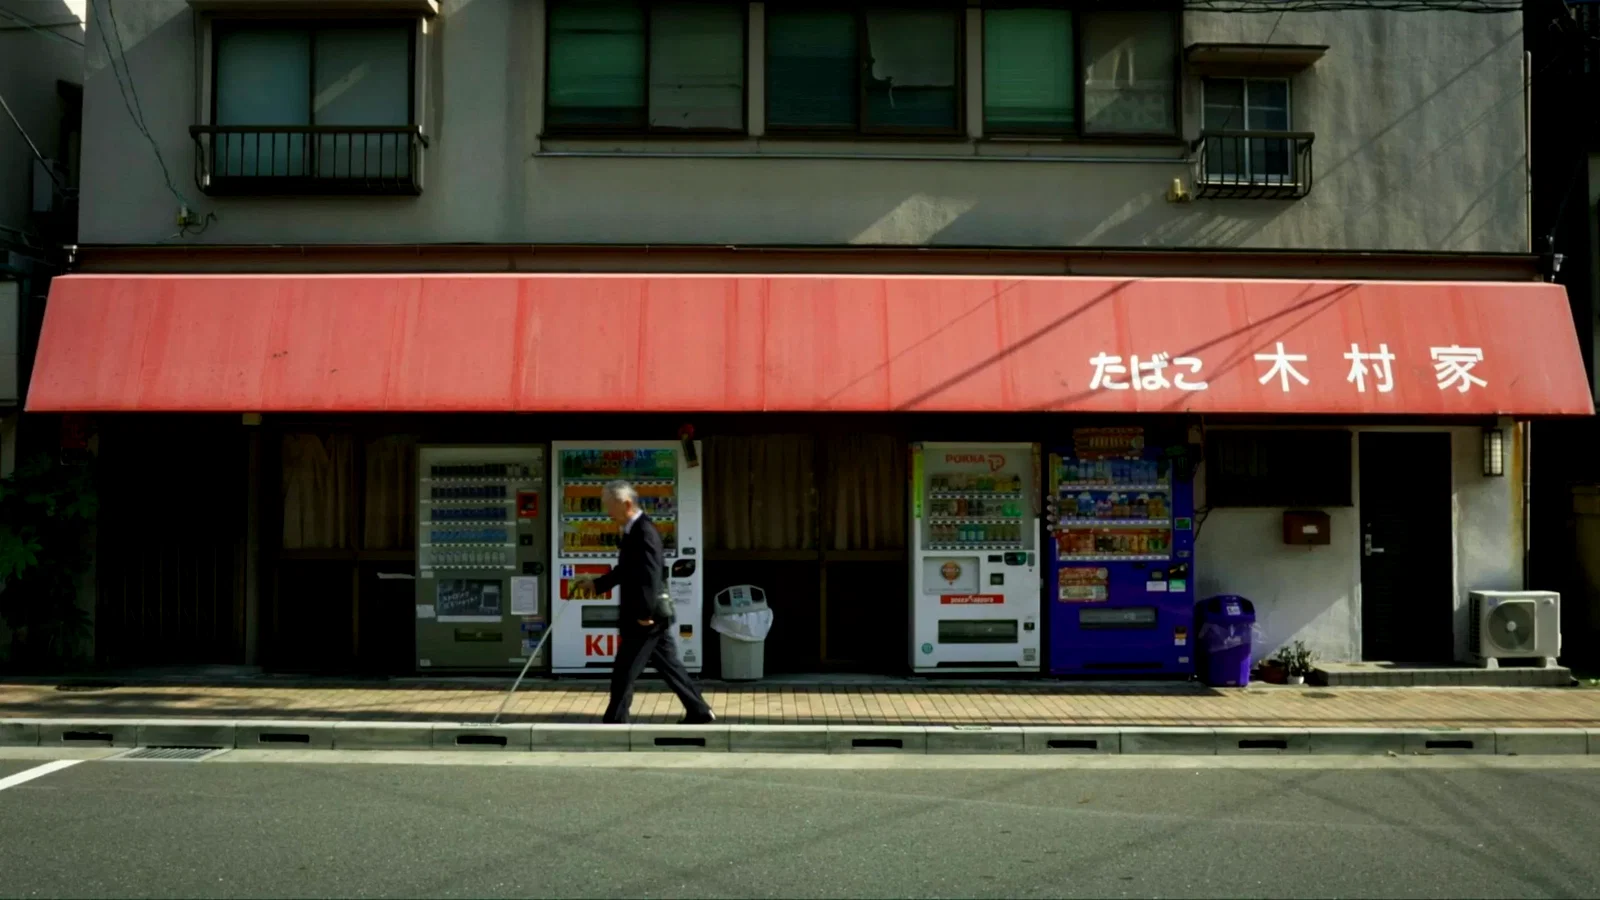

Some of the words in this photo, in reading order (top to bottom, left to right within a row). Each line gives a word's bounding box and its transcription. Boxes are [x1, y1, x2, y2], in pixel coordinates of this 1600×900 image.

[1089, 351, 1209, 391] たばこ
[1254, 342, 1488, 393] 木村家
